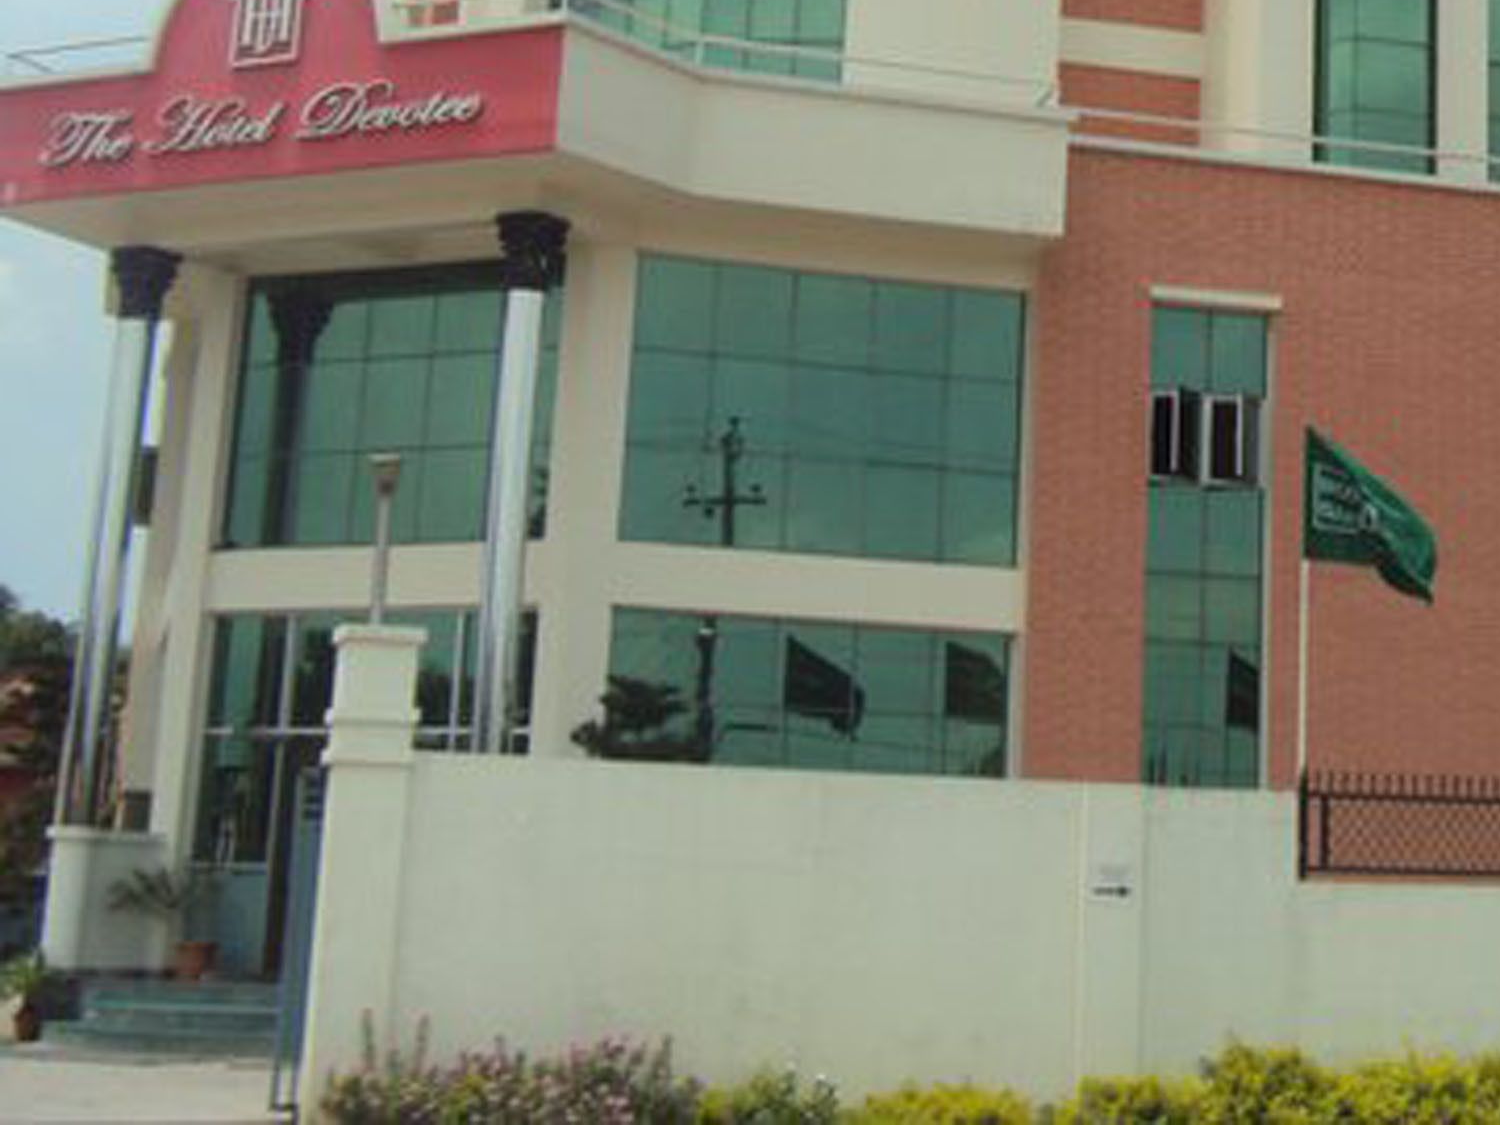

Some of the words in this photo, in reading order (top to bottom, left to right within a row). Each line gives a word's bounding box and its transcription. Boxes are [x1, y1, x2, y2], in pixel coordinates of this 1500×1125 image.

[39, 110, 132, 165] The
[139, 94, 284, 152] Hotel
[294, 78, 481, 140] Devotee
